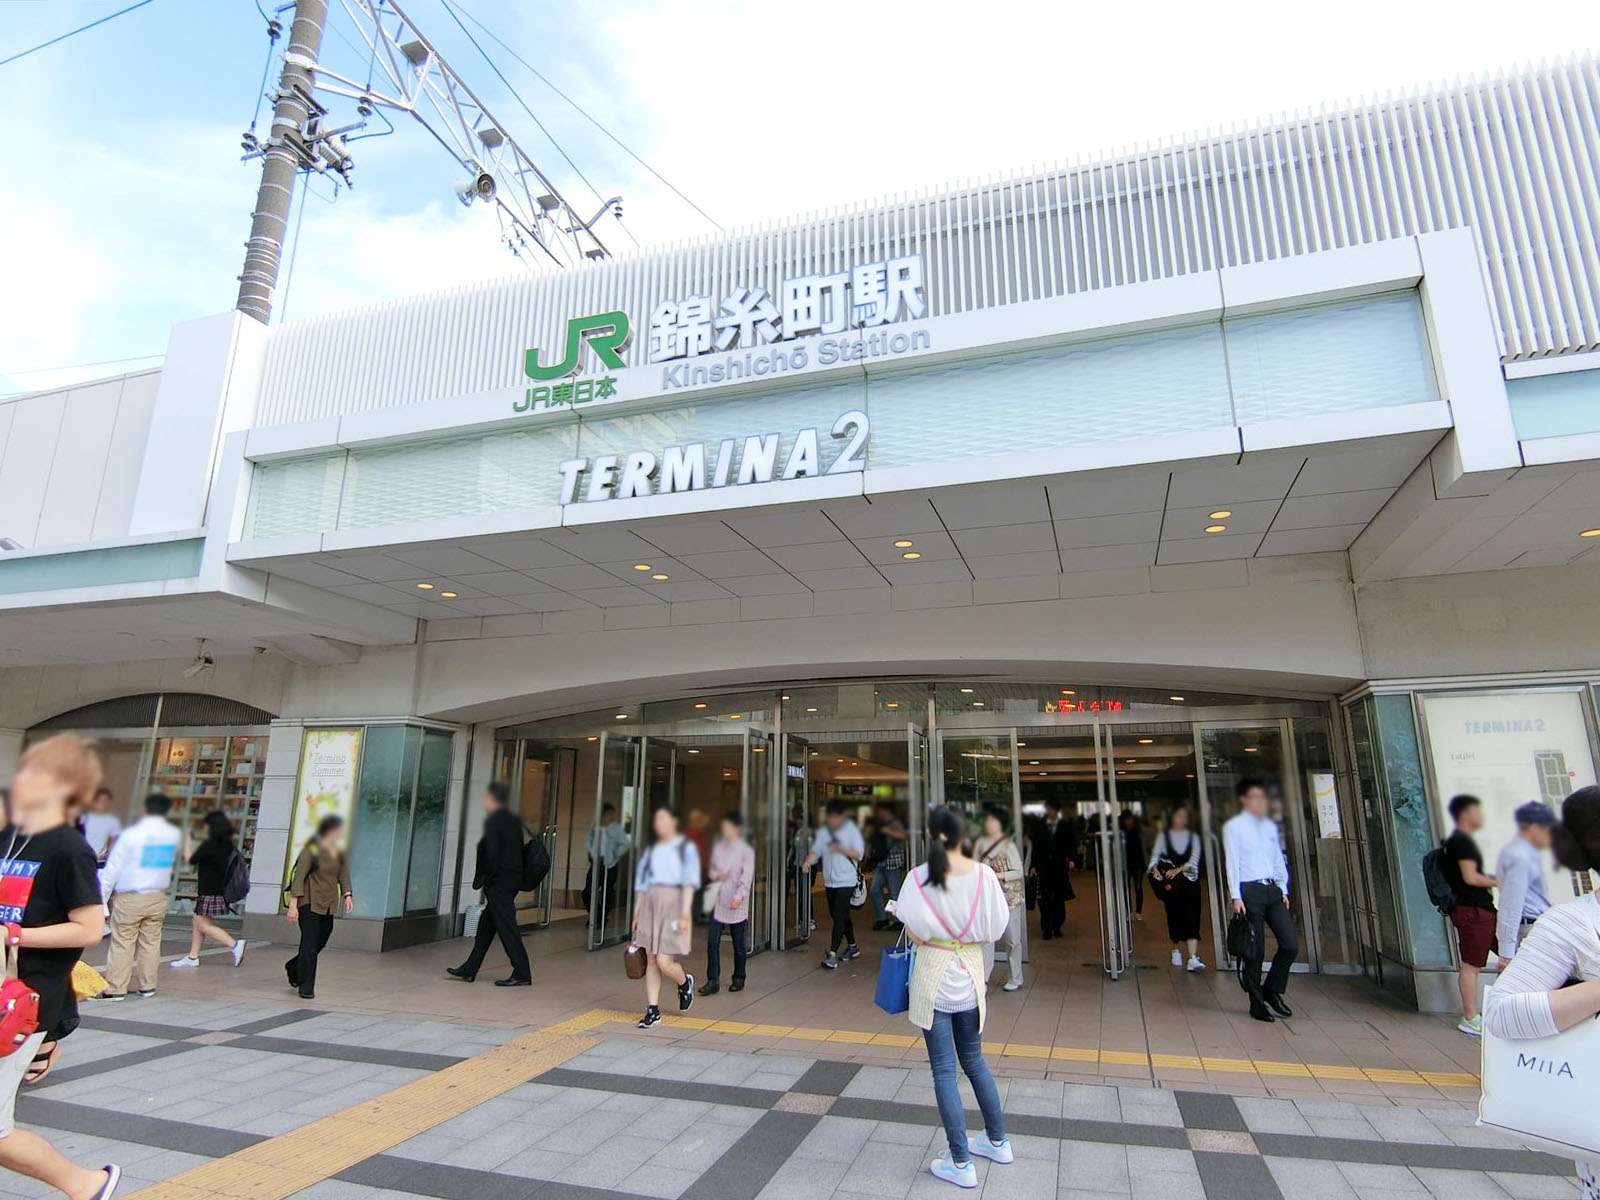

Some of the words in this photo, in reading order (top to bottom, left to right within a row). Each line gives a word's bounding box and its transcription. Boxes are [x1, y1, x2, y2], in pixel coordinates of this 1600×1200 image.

[650, 253, 926, 363] 錦糸町駅
[525, 310, 632, 380] JR
[662, 346, 808, 390] Kinshichō
[818, 329, 931, 365] Station
[513, 376, 618, 412] JR東日本
[1517, 1053, 1573, 1079] MIIA
